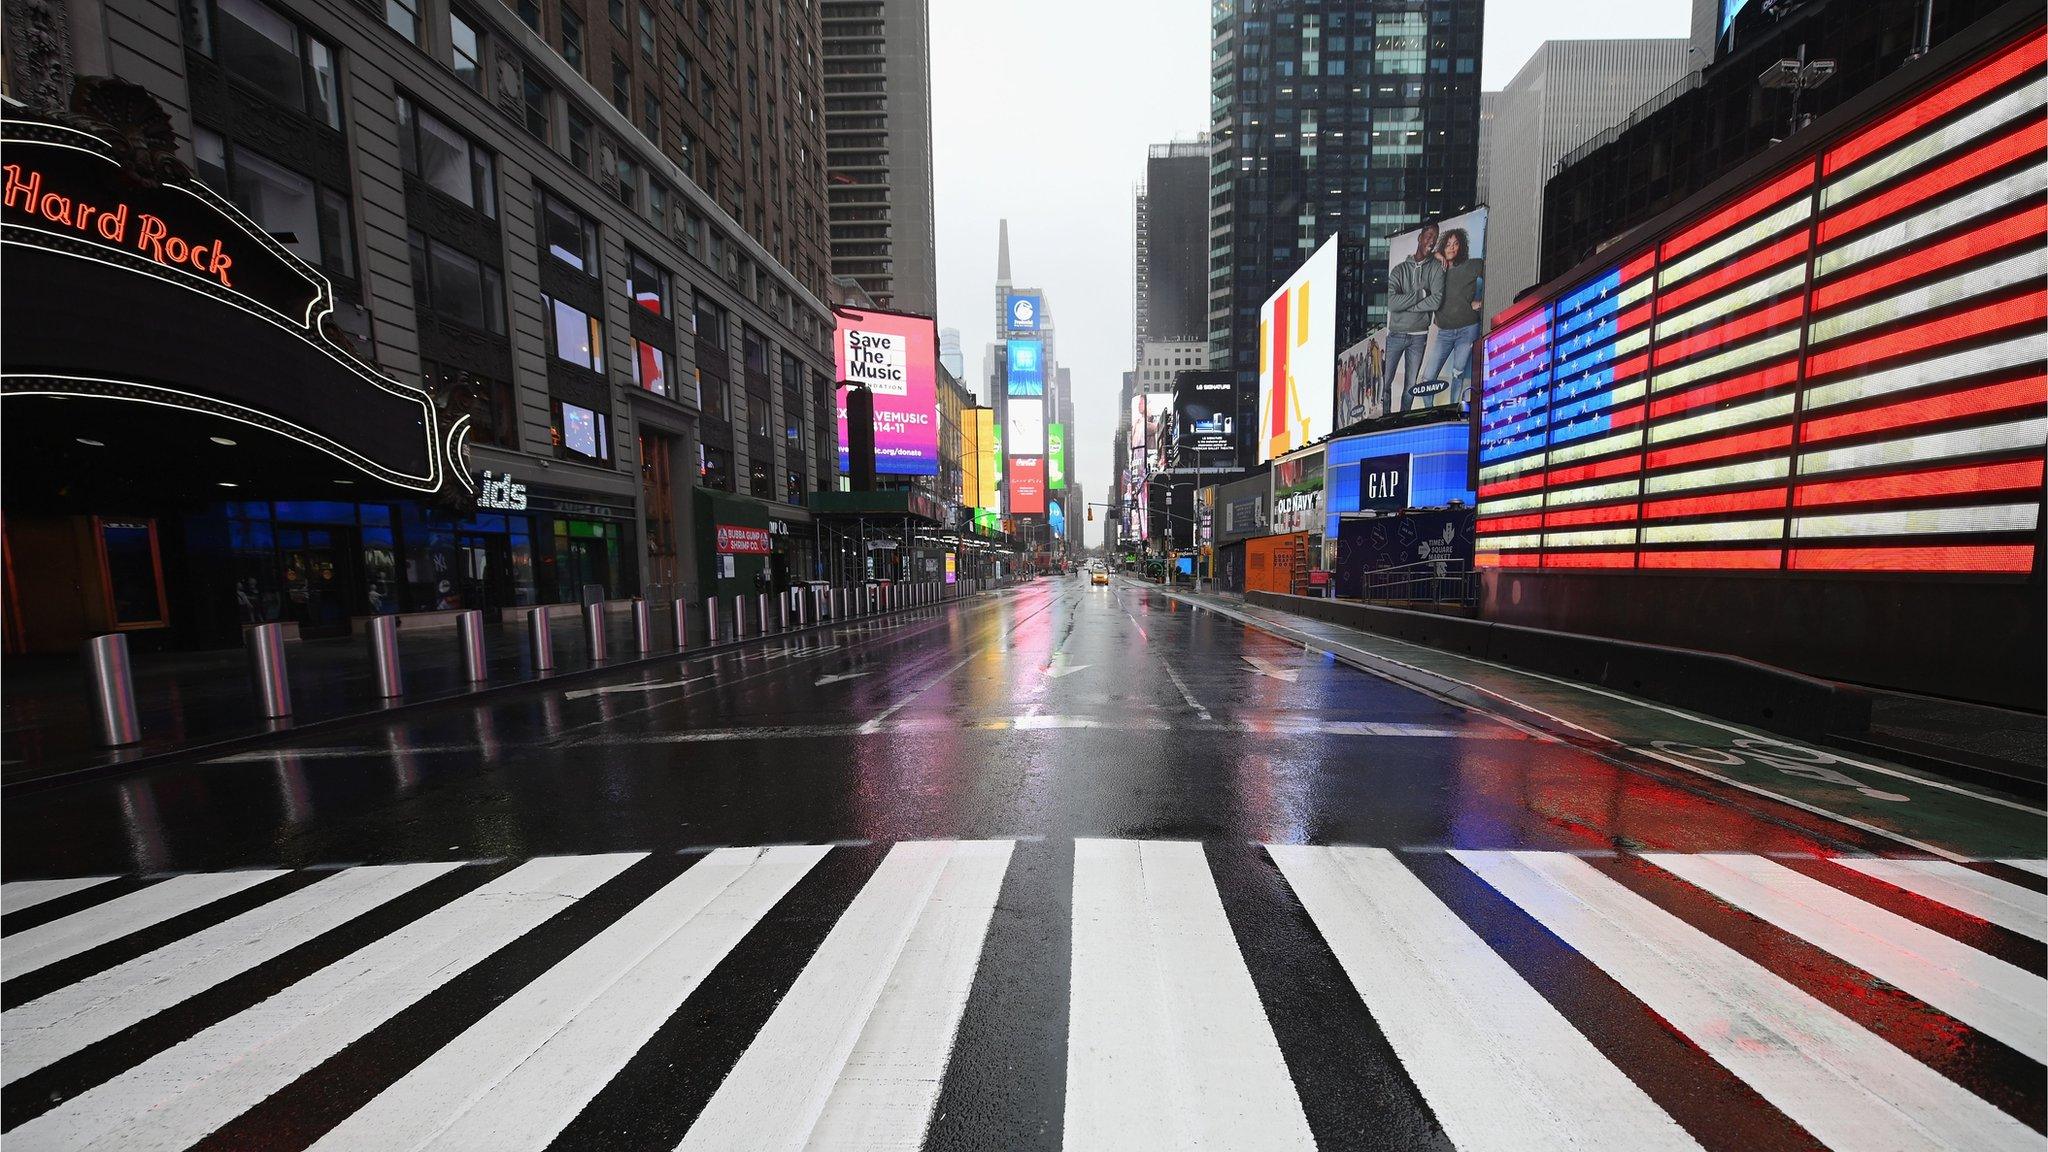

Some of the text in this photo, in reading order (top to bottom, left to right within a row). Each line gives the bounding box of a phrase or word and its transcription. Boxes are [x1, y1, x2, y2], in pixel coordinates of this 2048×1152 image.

[3, 164, 233, 287] Hard Rock
[849, 330, 891, 349] Save
[850, 346, 884, 364] The
[850, 361, 901, 381] Music
[1412, 382, 1445, 395] OLD NAVY
[477, 470, 527, 510] ids
[1369, 470, 1398, 499] GAP
[1278, 499, 1292, 514] OLD
[727, 529, 760, 540] BUBBA GUMP
[730, 540, 749, 550] SHRIMP
[1430, 545, 1453, 553] SQUARE
